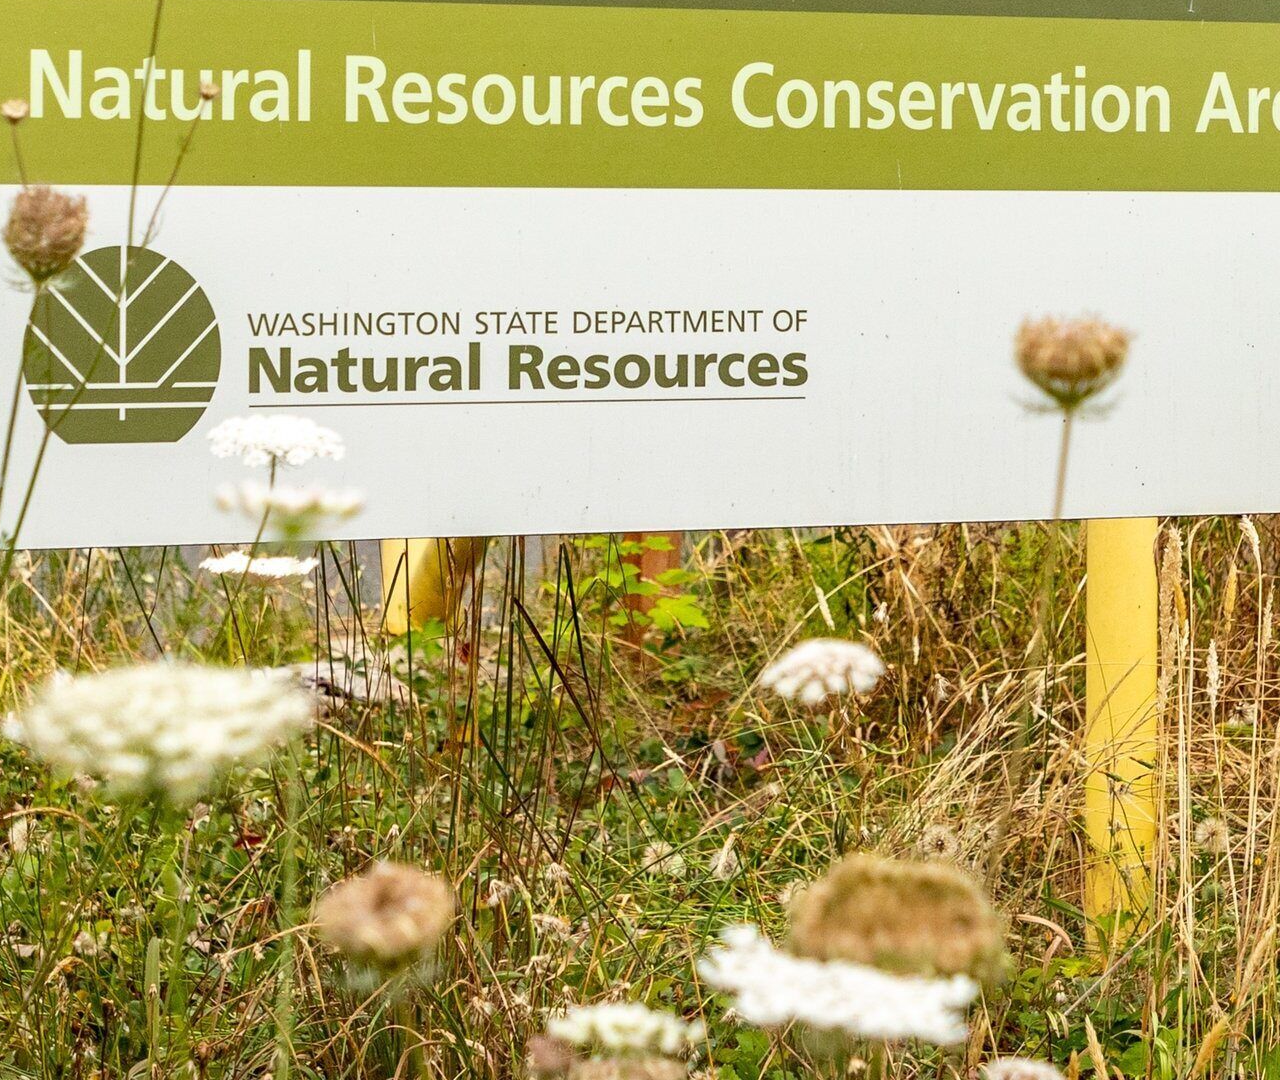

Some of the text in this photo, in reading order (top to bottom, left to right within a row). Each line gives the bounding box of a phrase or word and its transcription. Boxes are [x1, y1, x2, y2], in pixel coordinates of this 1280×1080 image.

[29, 48, 312, 123] Natural
[345, 54, 704, 128] Resources
[731, 62, 1171, 133] Conservation
[247, 309, 808, 337] WASHINGTON STATE DEPARTMENT OF
[248, 342, 809, 394] Natural Resources
